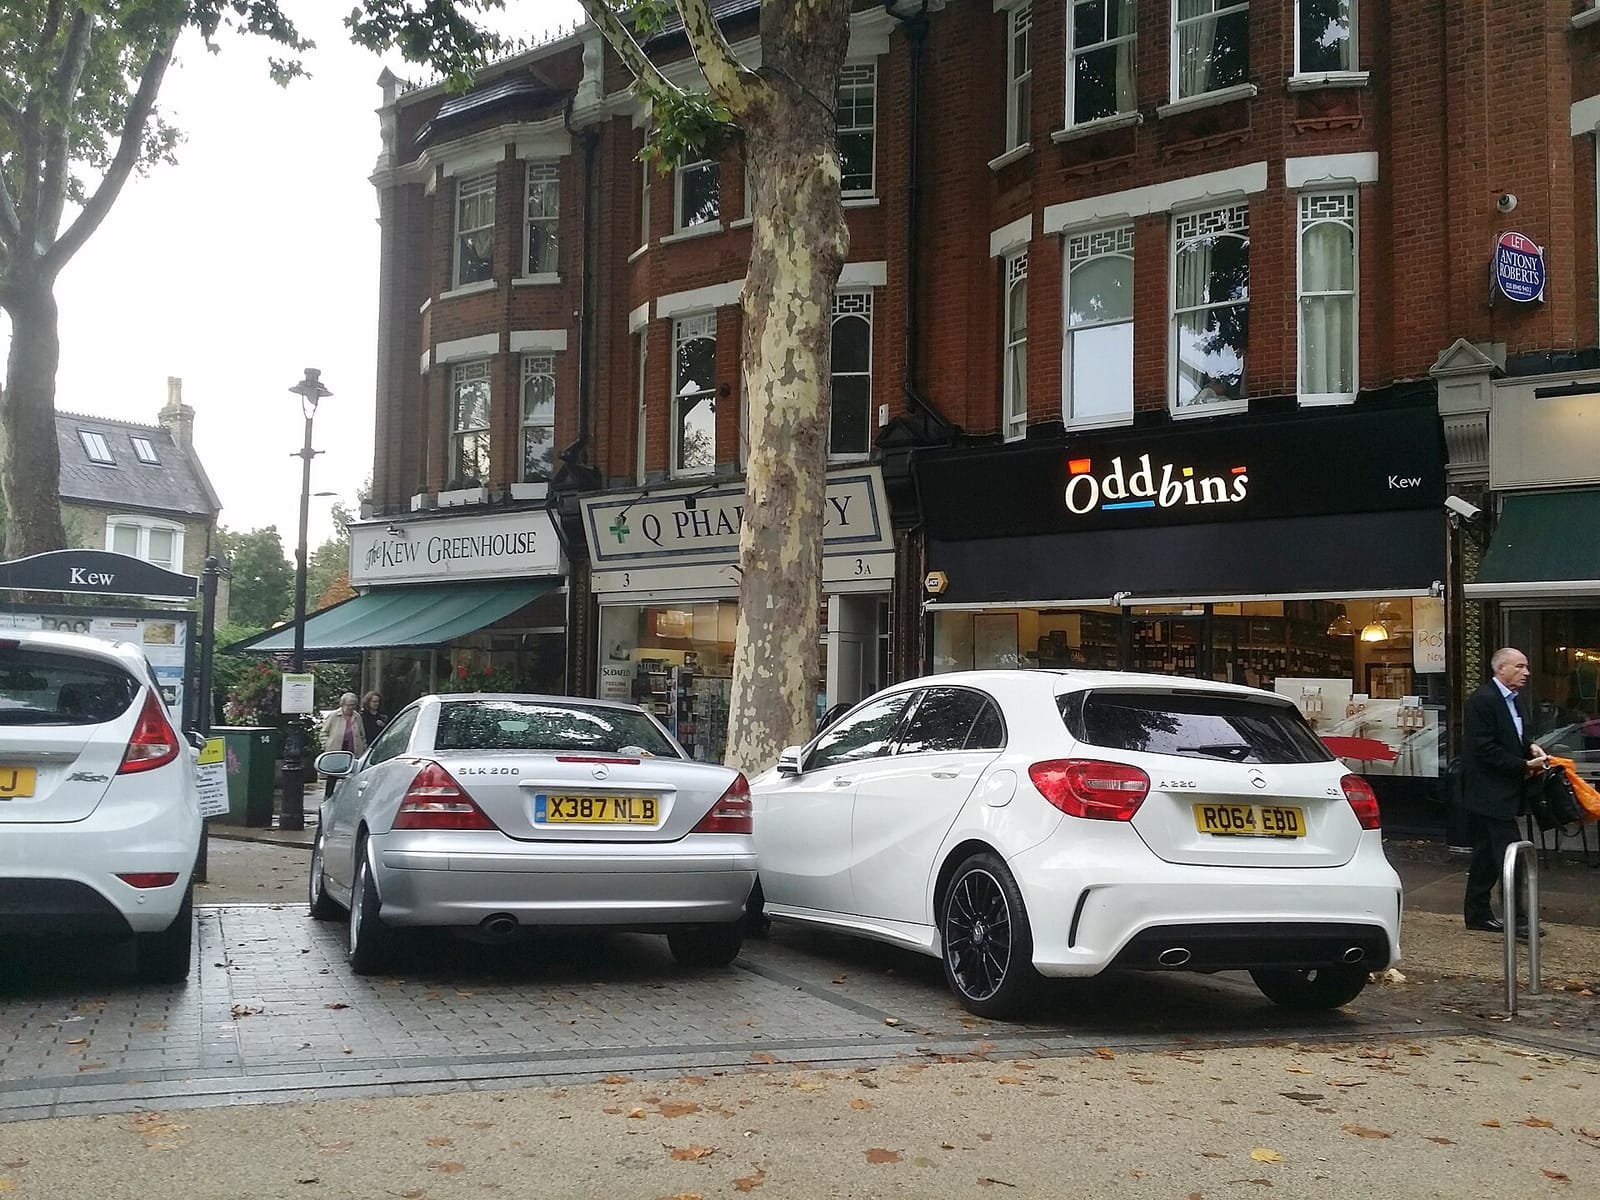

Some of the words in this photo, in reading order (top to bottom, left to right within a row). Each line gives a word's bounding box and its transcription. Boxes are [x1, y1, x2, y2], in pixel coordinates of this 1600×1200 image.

[1512, 235, 1525, 249] LET
[1501, 249, 1537, 270] ANTONY
[1500, 263, 1540, 285] ROBERTS
[1065, 453, 1249, 514] Oddbins
[1388, 475, 1422, 489] Kew
[642, 514, 664, 547] Q
[381, 540, 421, 567] KEW
[427, 531, 537, 564] GREENHOUSE
[69, 567, 116, 586] Kew
[854, 559, 872, 576] 3A
[623, 573, 630, 588] 3
[458, 767, 487, 776] SLK
[490, 767, 520, 776] 200
[1170, 781, 1197, 789] 220
[550, 797, 608, 818] X387
[614, 798, 655, 819] NLB
[1203, 806, 1257, 831] RO64
[1261, 808, 1298, 832] EBD
